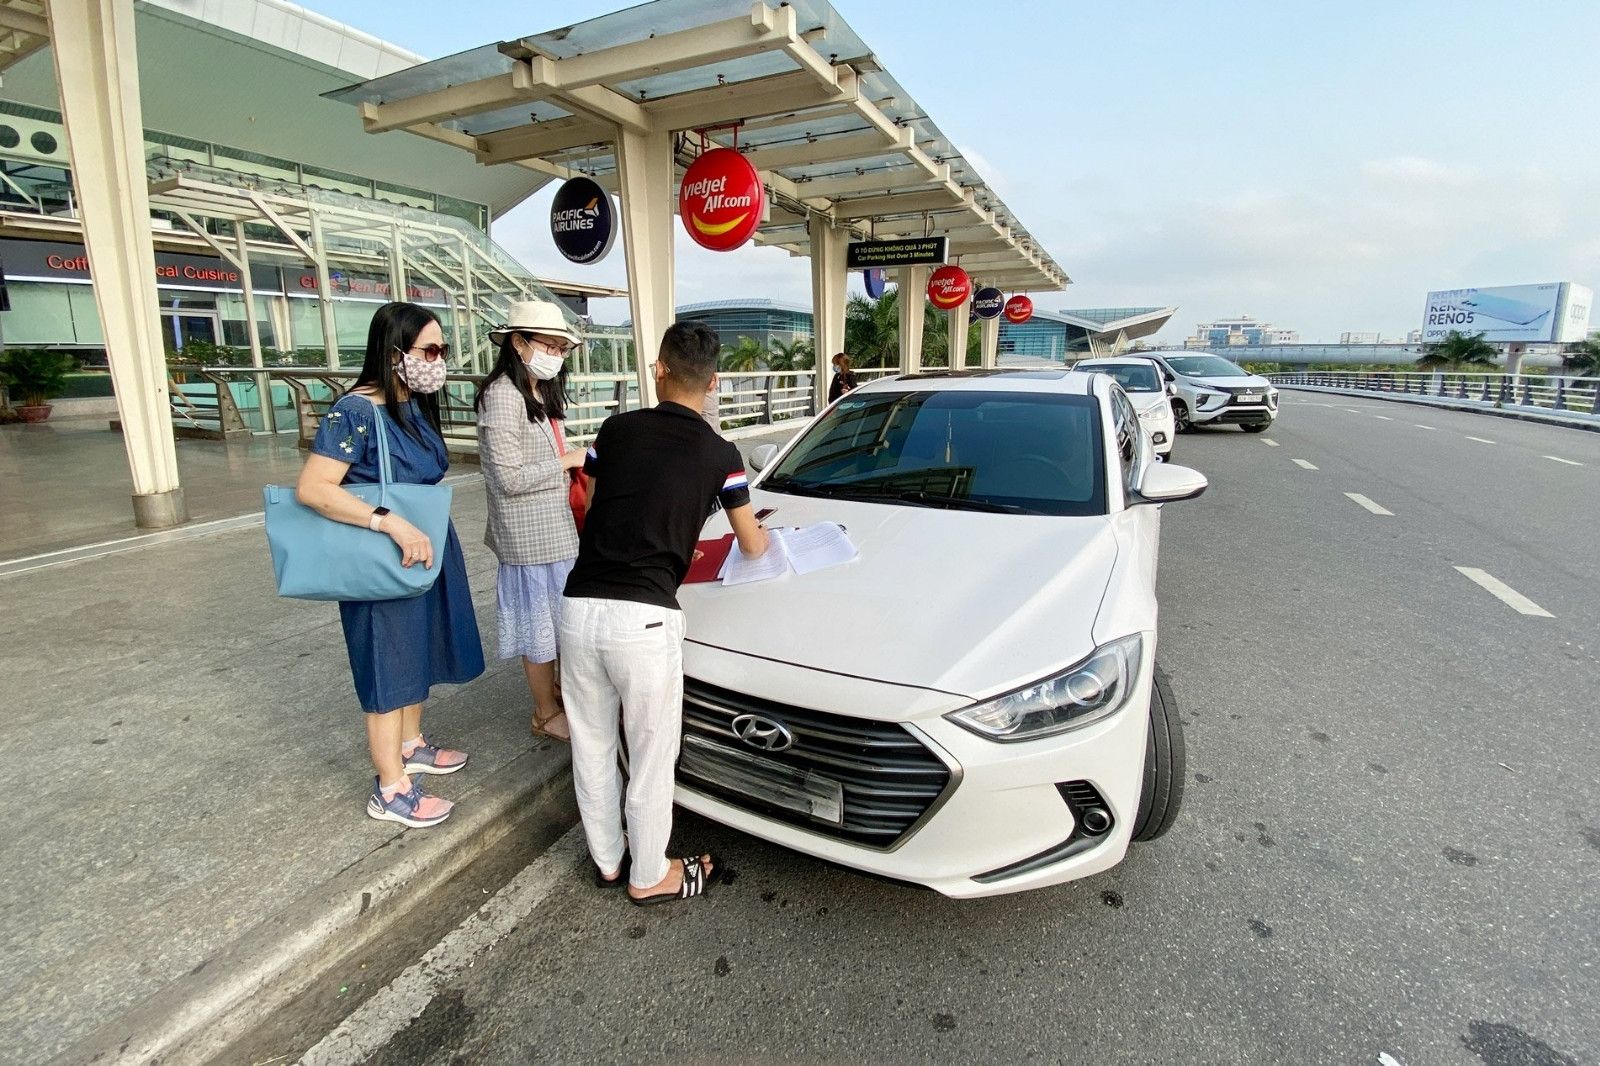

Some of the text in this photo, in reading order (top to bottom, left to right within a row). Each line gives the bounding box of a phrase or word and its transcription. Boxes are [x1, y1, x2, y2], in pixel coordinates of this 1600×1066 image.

[552, 208, 584, 222] PACIFIC
[554, 218, 594, 232] AIRLINES
[47, 254, 238, 282] Coff cal Cuisine
[1428, 311, 1475, 326] RENO5
[1426, 329, 1447, 337] OPPO
